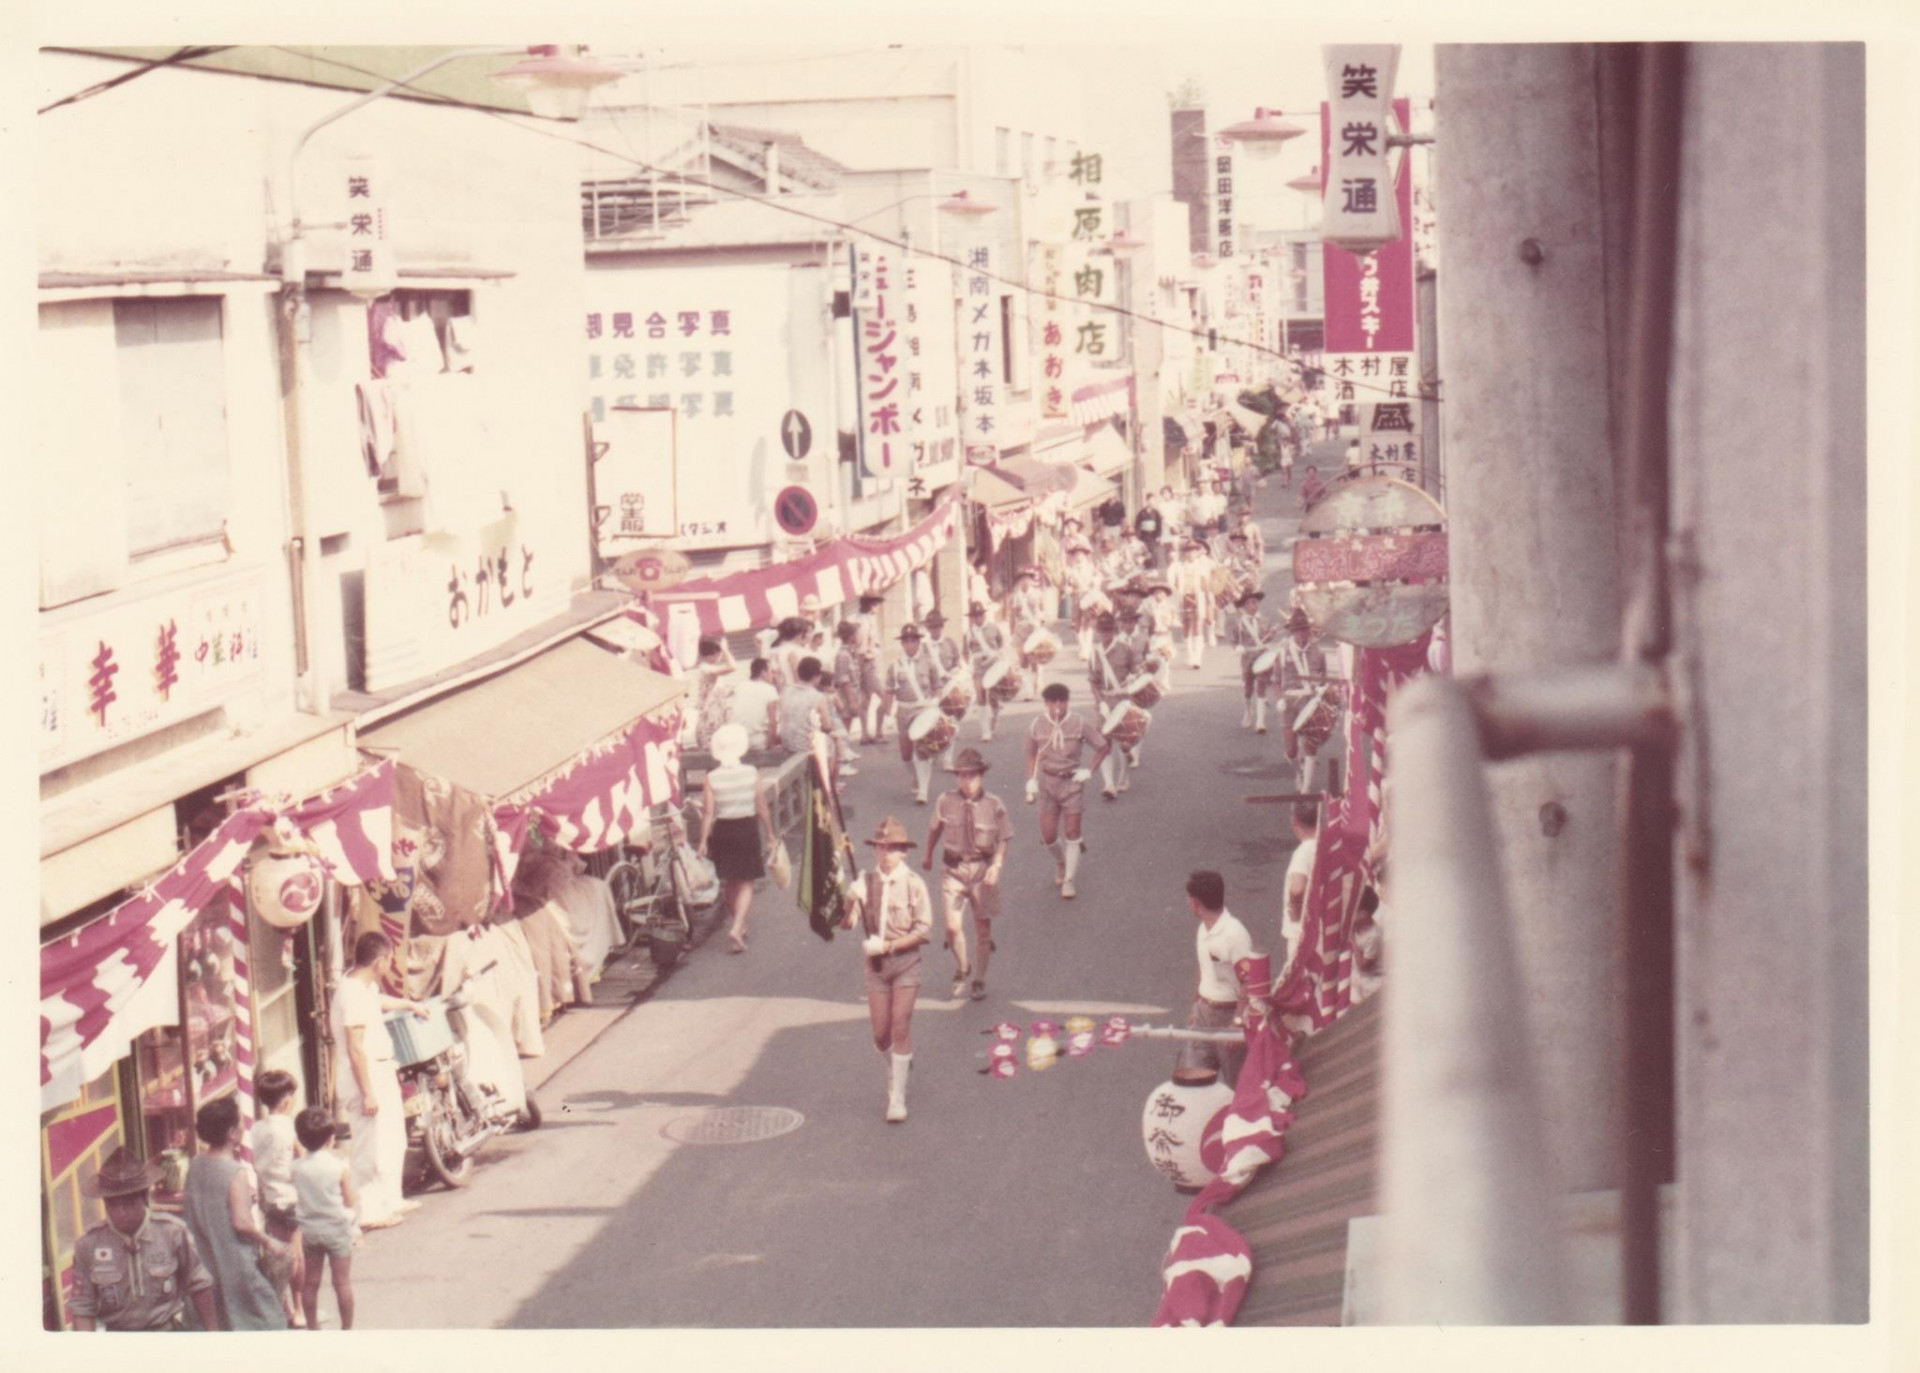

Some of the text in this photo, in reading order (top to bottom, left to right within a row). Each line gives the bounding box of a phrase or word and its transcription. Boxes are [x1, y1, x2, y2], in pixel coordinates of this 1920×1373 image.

[1341, 64, 1378, 213] 笑栄通
[348, 175, 372, 272] 笑栄通
[1068, 151, 1106, 355] 相原肉店
[864, 255, 901, 468] ニュージャンボー
[1043, 320, 1063, 412] あおき
[1333, 356, 1409, 377] 木村屋
[448, 544, 533, 629] おかもと
[88, 618, 181, 728] 幸華
